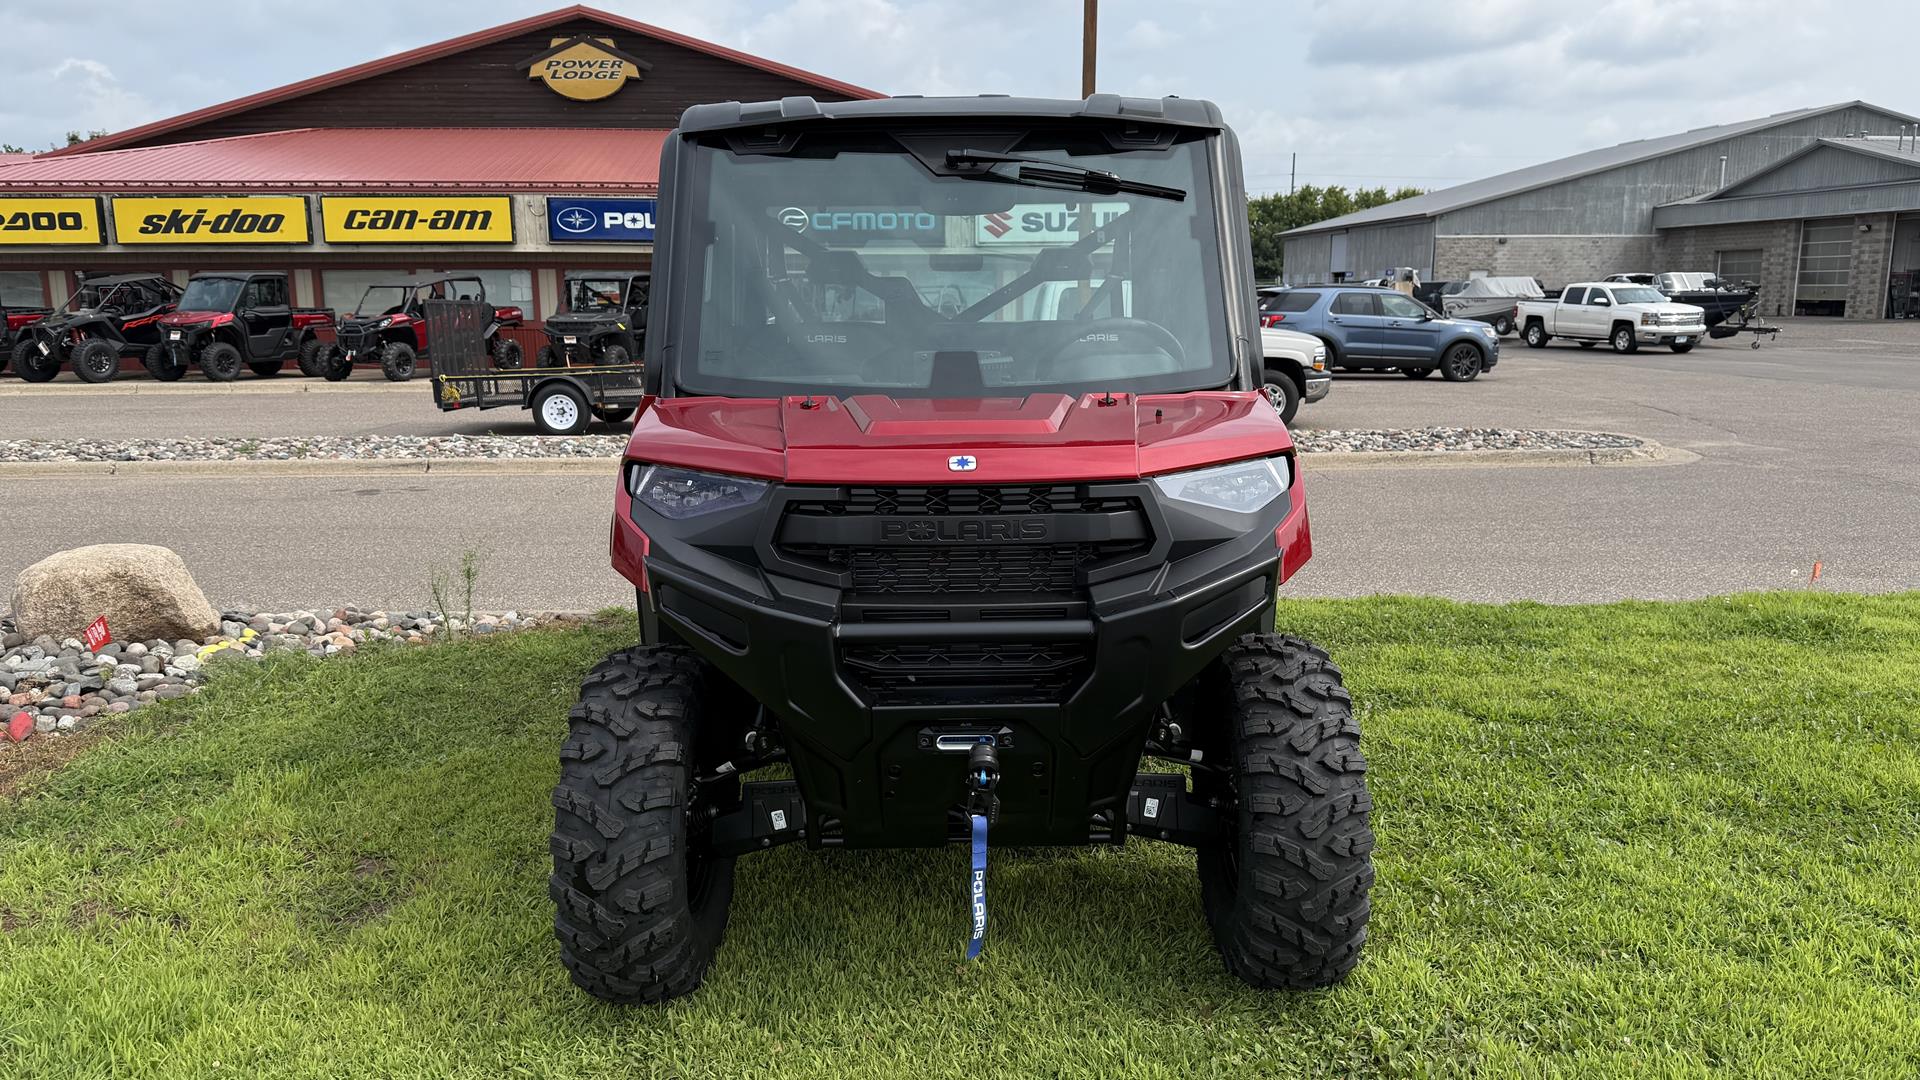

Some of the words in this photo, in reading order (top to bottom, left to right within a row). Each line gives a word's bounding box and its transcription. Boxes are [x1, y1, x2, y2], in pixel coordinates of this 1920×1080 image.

[545, 60, 624, 71] POWER
[550, 70, 621, 80] LODGE
[138, 209, 285, 234] ski-doo
[343, 210, 492, 230] can-am
[603, 212, 656, 229] POL
[811, 212, 935, 231] CFMOTO
[806, 334, 847, 343] LARIS
[879, 520, 1048, 542] POLARIS
[973, 870, 985, 940] POLARIS
